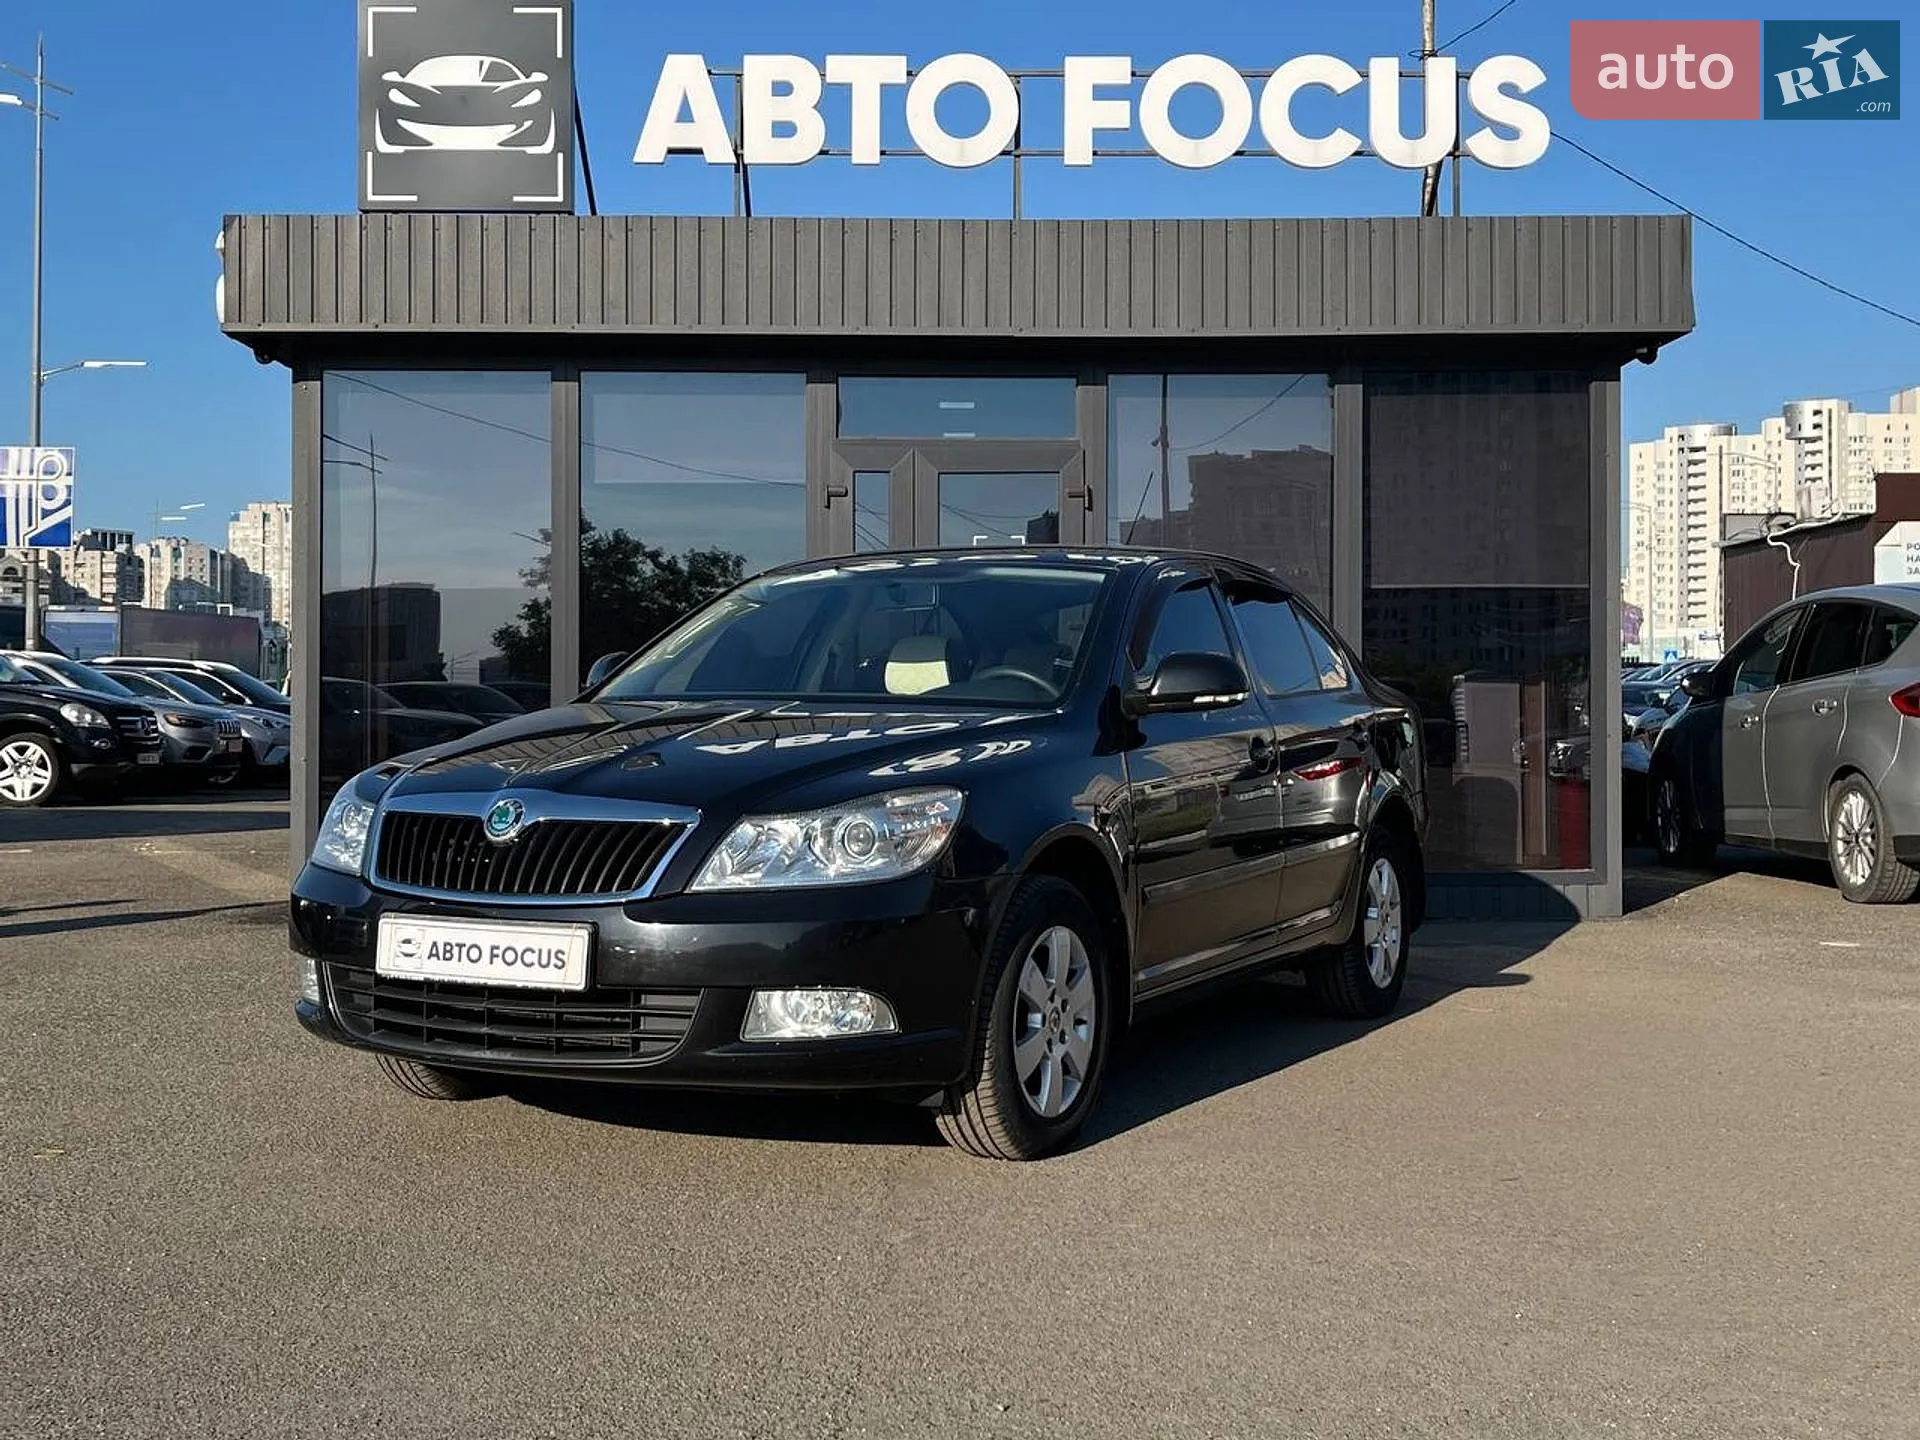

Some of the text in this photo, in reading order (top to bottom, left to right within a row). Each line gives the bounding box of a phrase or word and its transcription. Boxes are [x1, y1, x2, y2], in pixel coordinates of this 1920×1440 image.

[633, 53, 1551, 168] АВТО FOCUS
[427, 941, 567, 970] АВТО FOCUS
